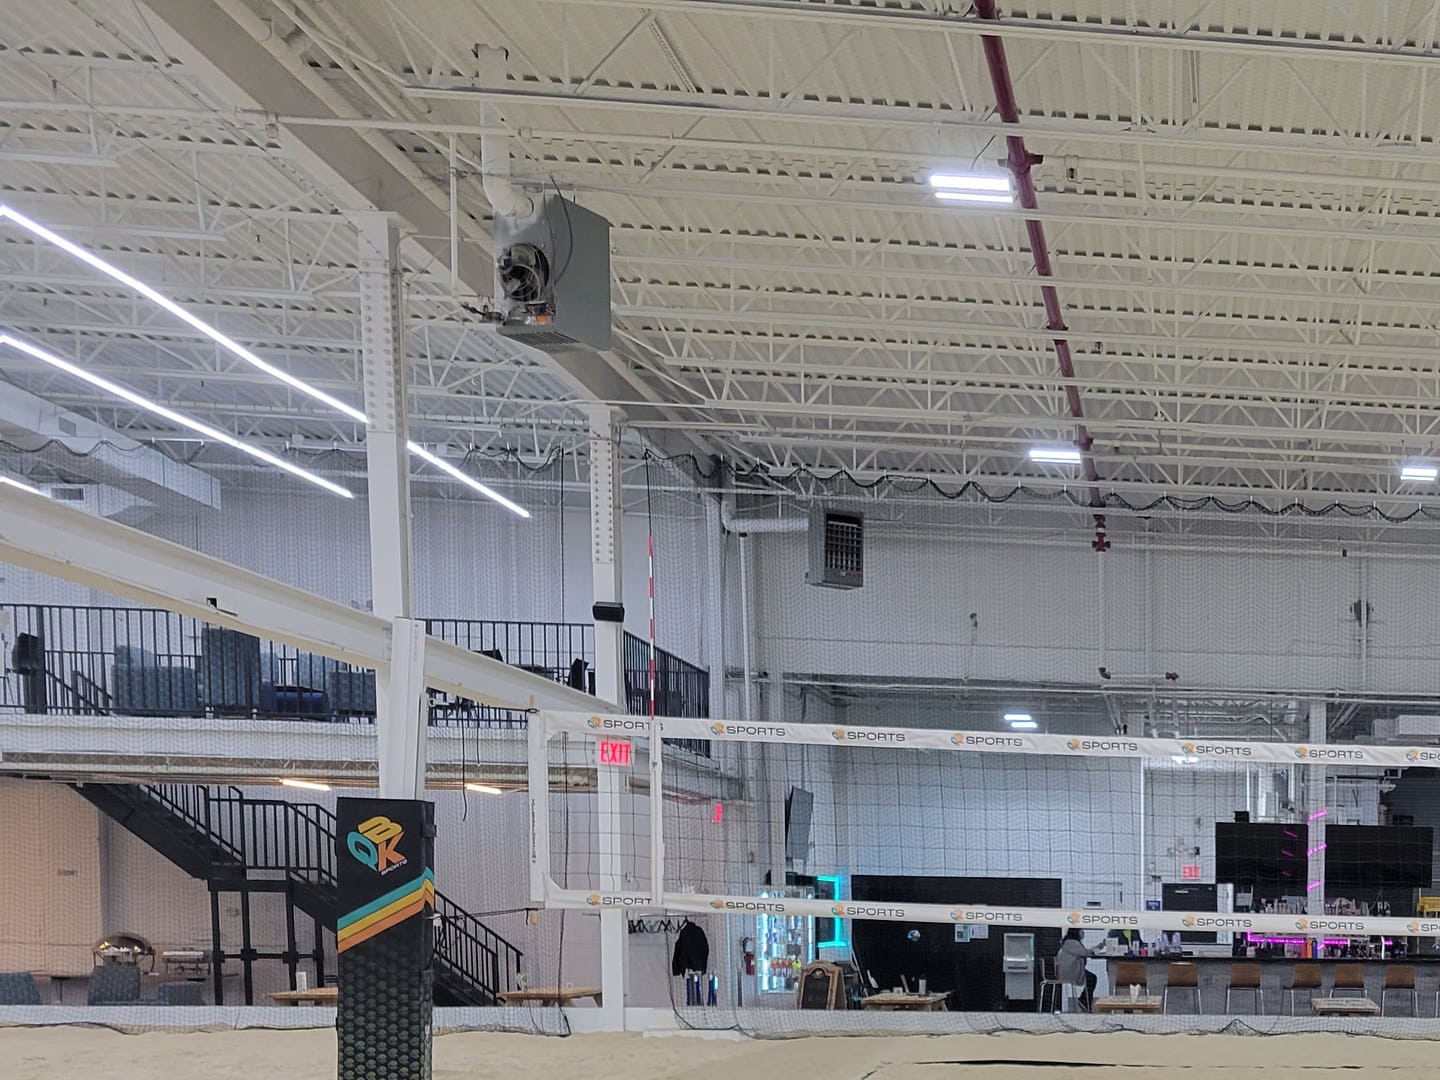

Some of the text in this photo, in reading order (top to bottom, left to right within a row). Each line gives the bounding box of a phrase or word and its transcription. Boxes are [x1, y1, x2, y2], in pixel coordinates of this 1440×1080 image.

[600, 741, 631, 765] EXIT
[726, 725, 786, 737] SPORTS
[846, 731, 906, 743] SPORTS
[965, 735, 1023, 747] SPORTS
[1081, 740, 1139, 752] SPORTS
[1195, 745, 1252, 756] SPORTS
[1309, 749, 1364, 760] SPORTS
[602, 896, 653, 906] SPORT
[726, 901, 785, 913] SPORTS
[846, 906, 905, 918] SPORTS
[965, 911, 1023, 922] SPORTS
[1081, 915, 1139, 925] SPORTS
[1196, 917, 1253, 928] SPORTS
[1309, 920, 1365, 931] SPORTS
